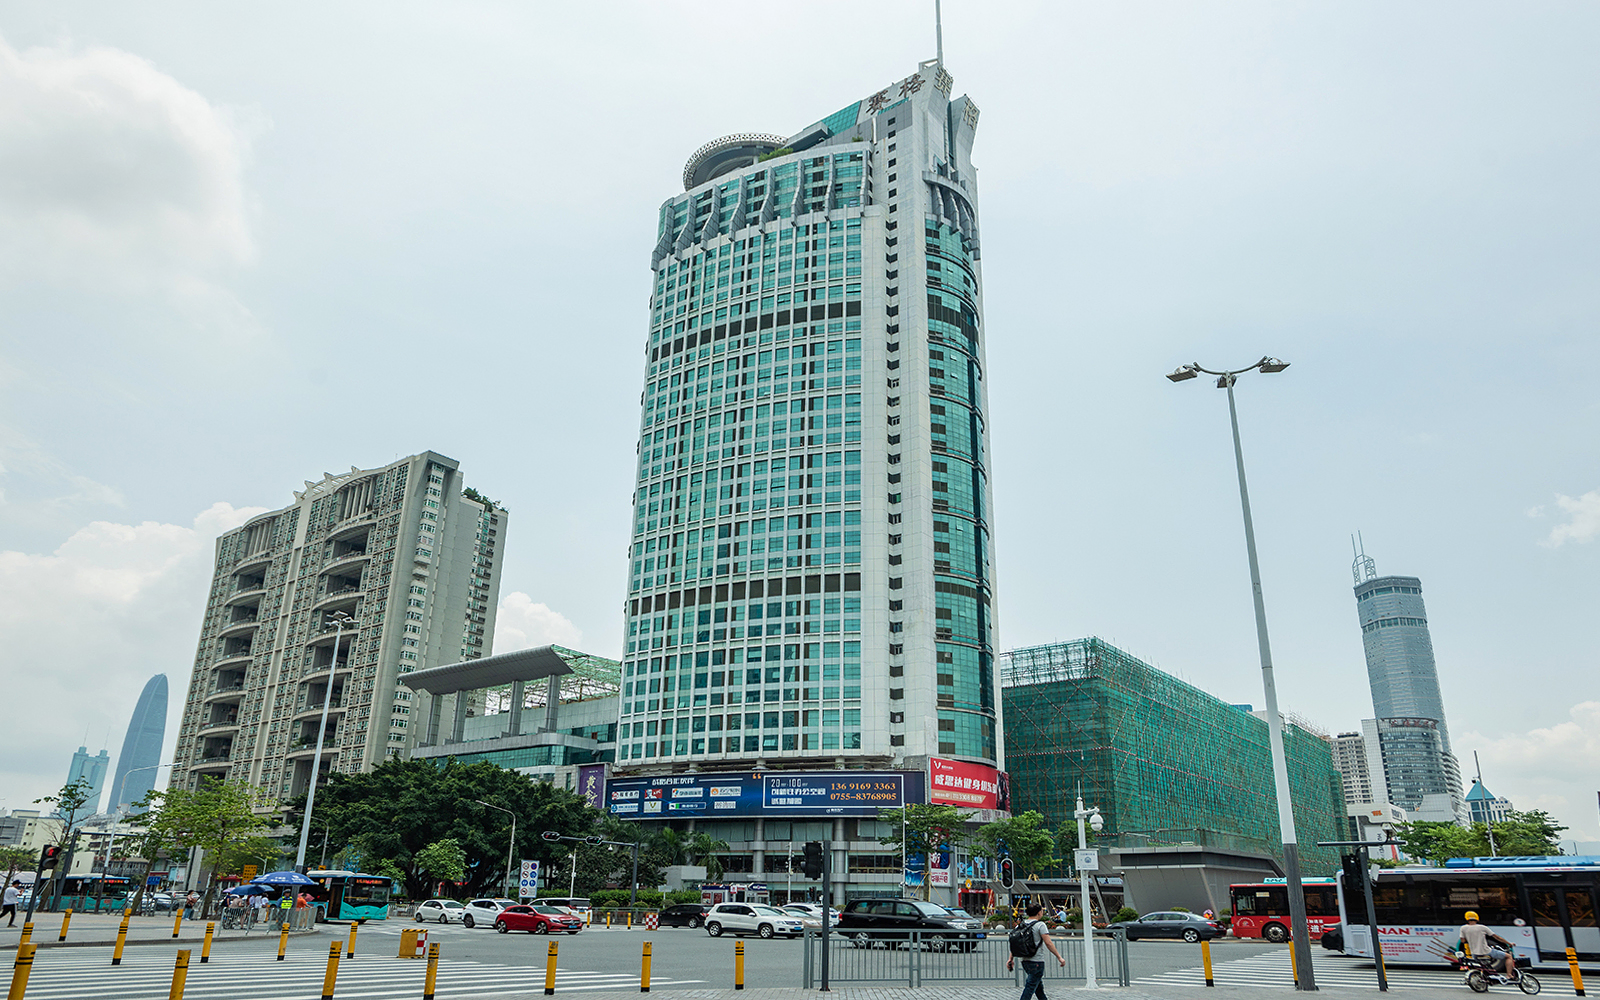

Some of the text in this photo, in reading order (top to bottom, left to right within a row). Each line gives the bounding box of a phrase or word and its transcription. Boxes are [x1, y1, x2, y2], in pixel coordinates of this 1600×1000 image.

[831, 782, 896, 791] 136 9169 3363
[830, 792, 897, 801] 0755-83768905
